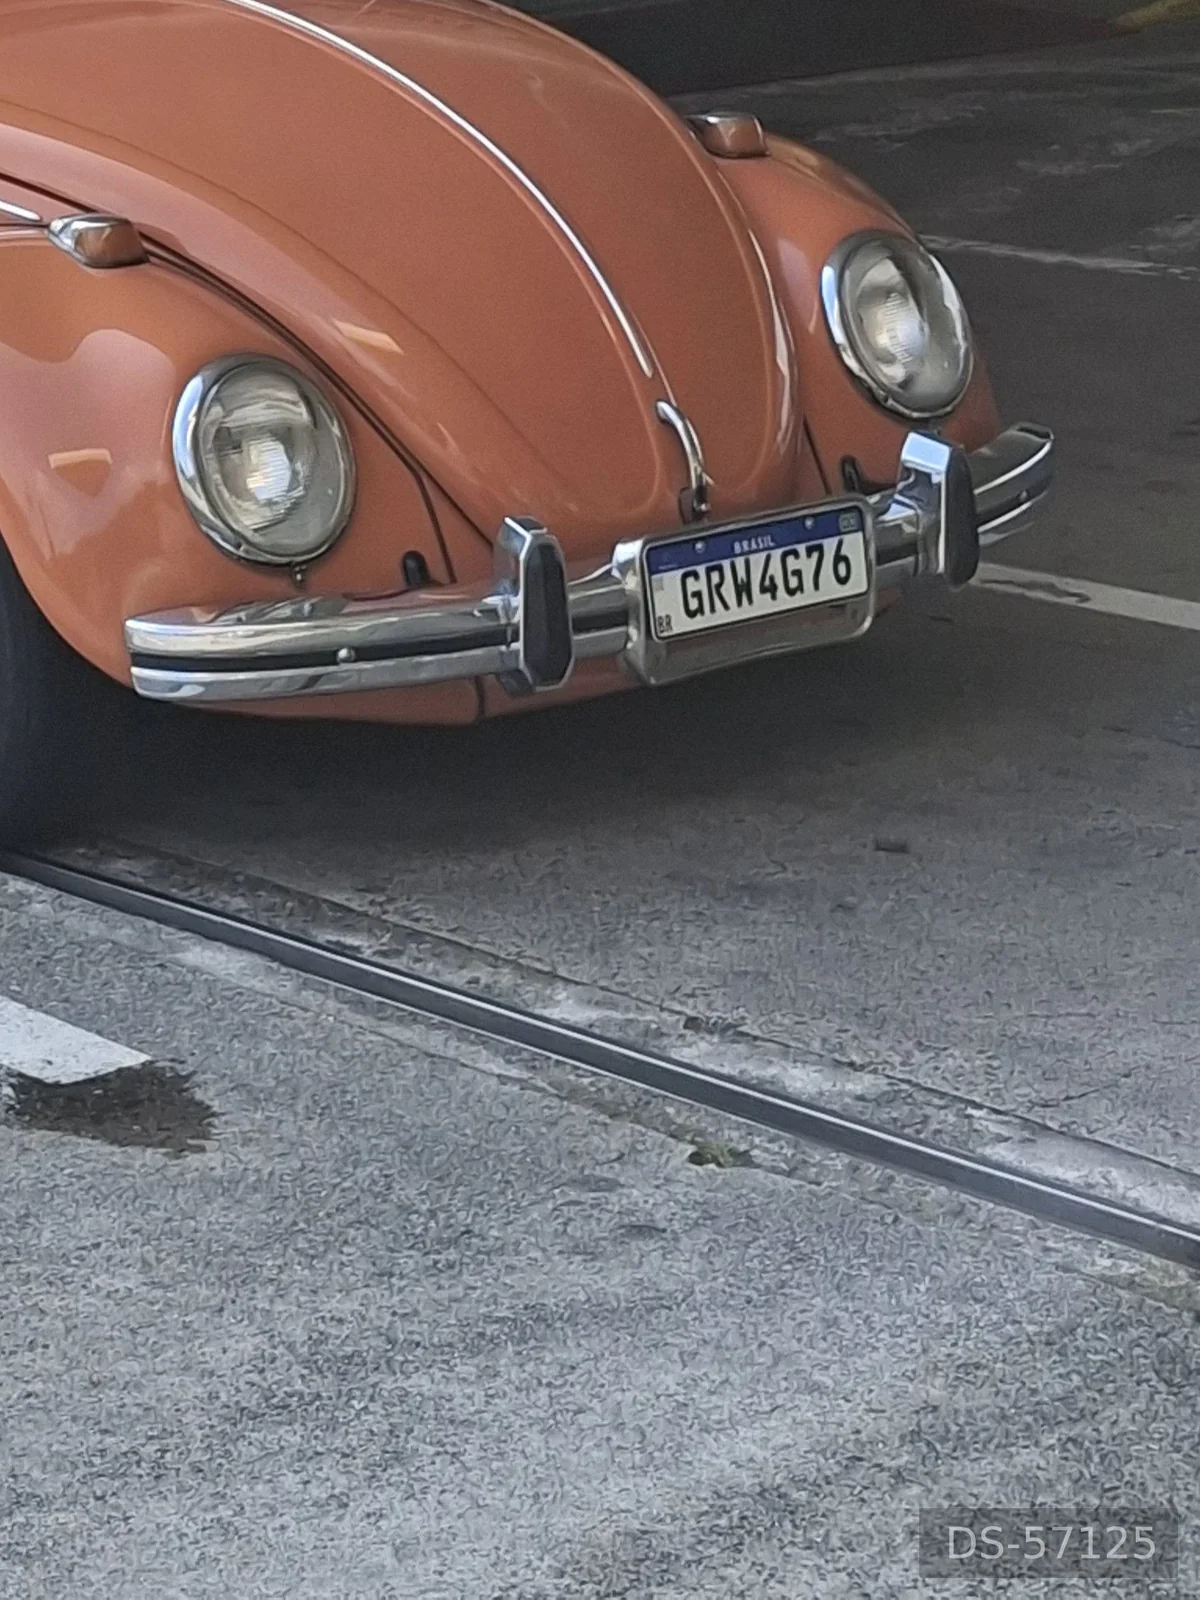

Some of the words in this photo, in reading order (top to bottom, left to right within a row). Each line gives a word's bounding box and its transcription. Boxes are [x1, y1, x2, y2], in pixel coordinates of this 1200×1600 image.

[734, 533, 776, 555] BRASIL
[679, 537, 852, 620] GRW4G76
[656, 613, 674, 635] BR
